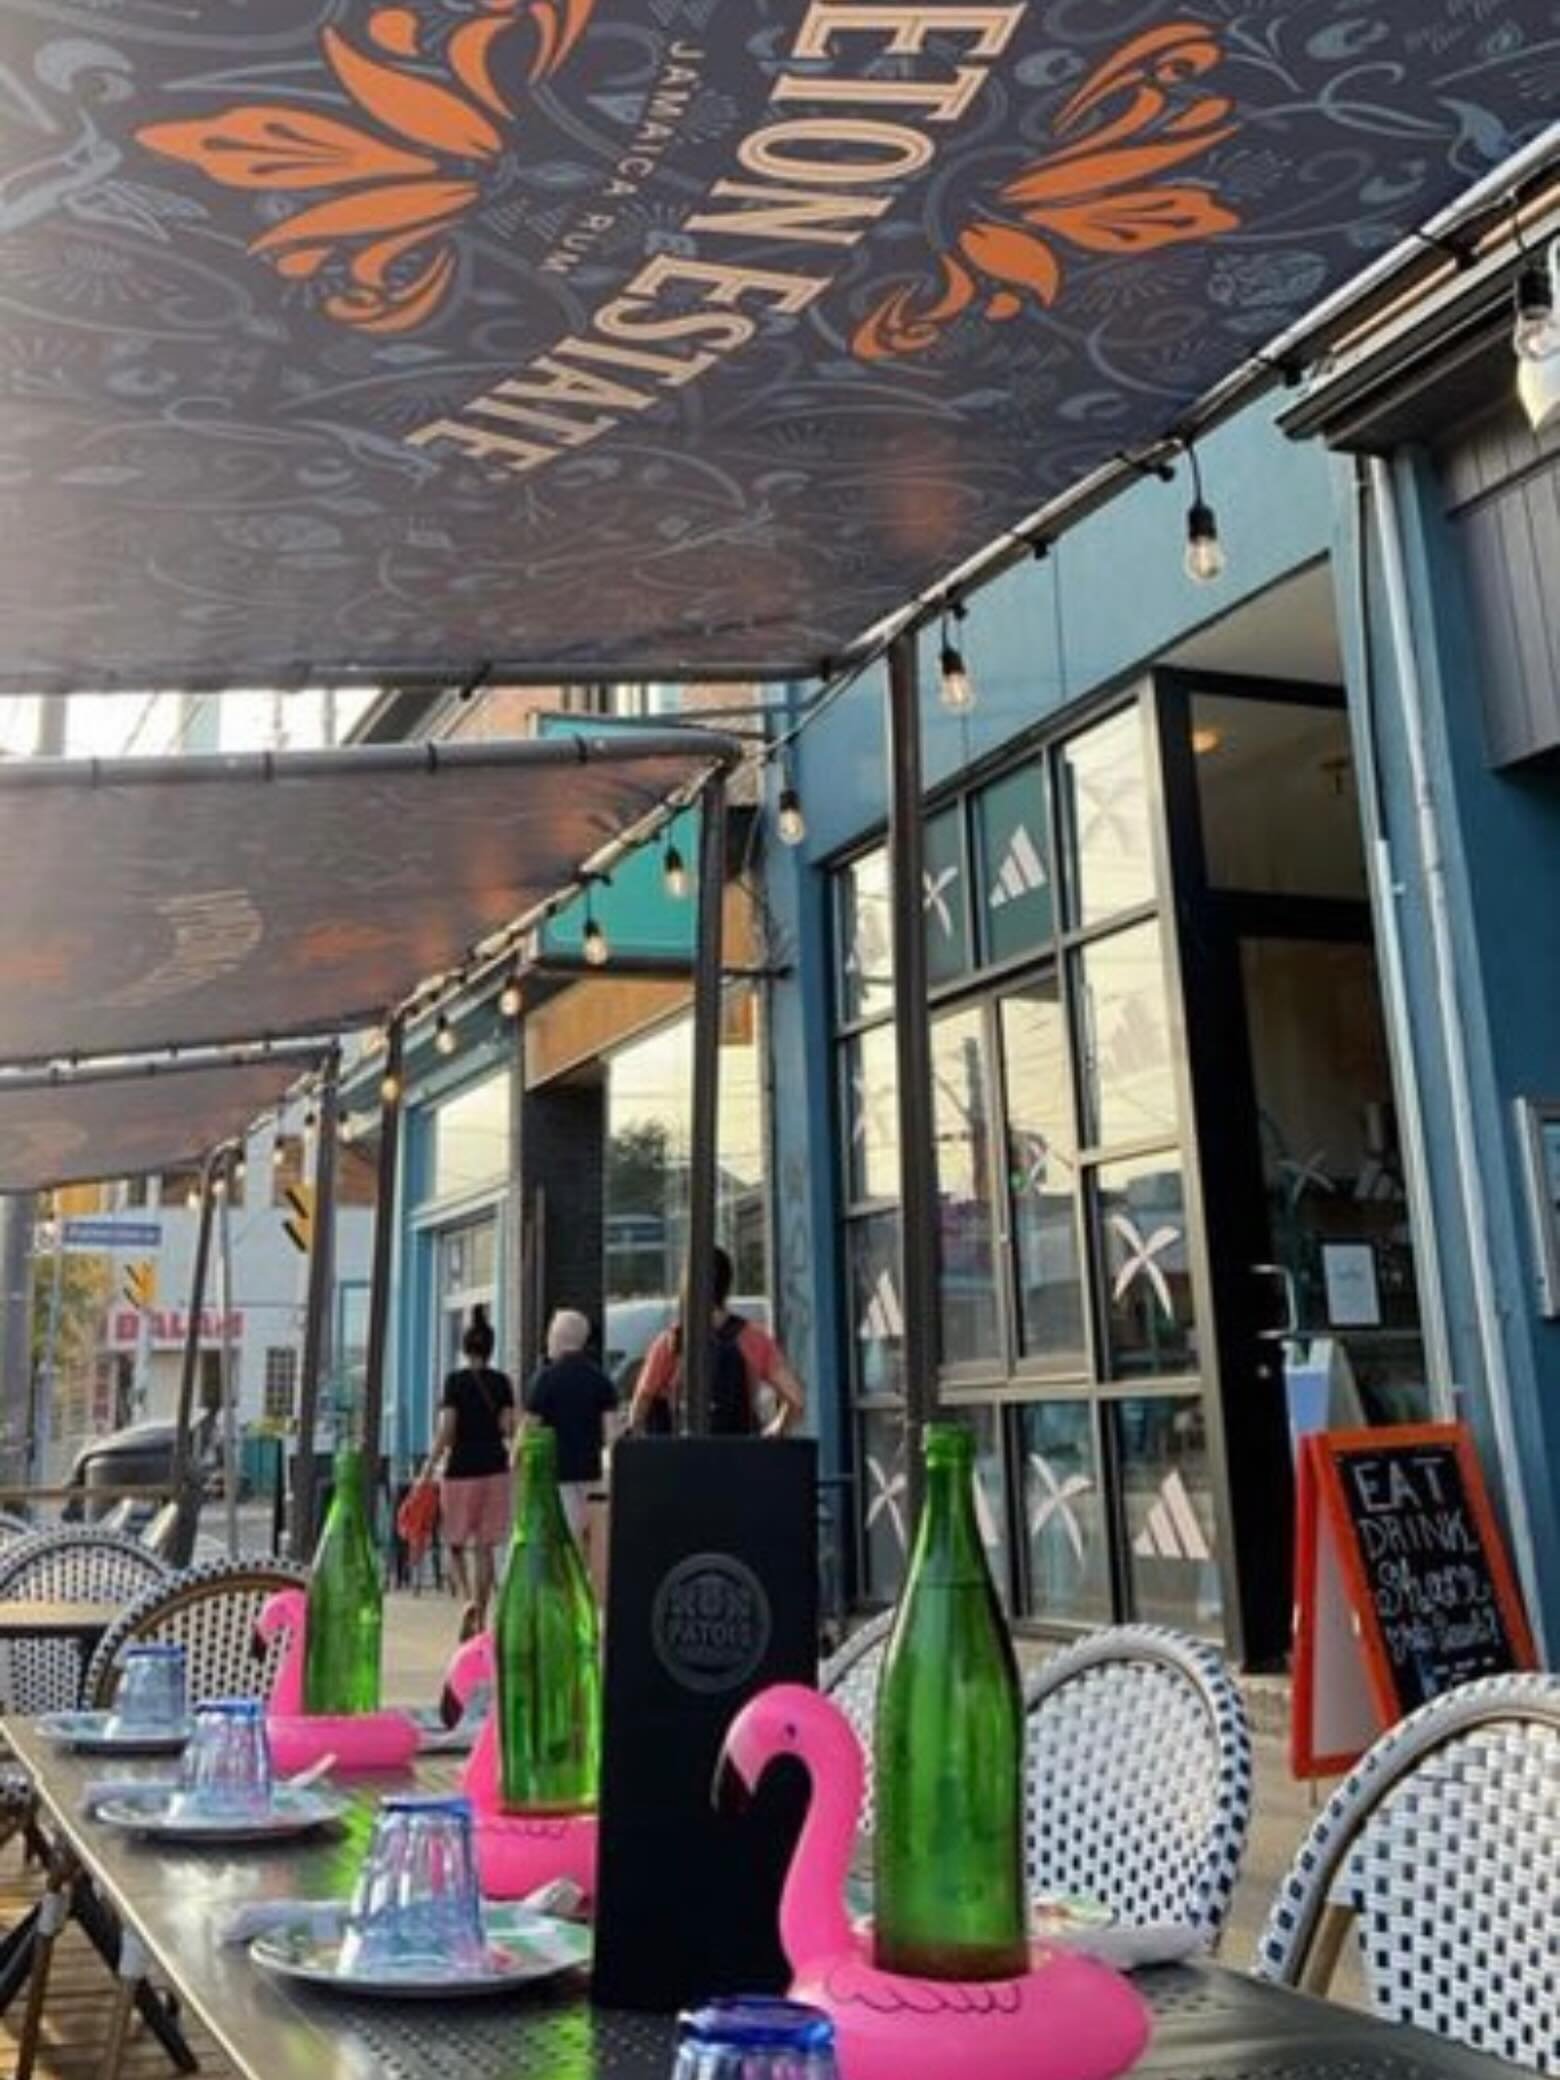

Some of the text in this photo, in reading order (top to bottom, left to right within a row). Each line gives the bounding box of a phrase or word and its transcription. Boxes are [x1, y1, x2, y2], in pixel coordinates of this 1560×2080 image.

[538, 41, 704, 272] JAMAICA RUM
[405, 254, 834, 472] ESTATE
[1354, 1456, 1443, 1512] EAT
[1358, 1508, 1480, 1560] DRINK
